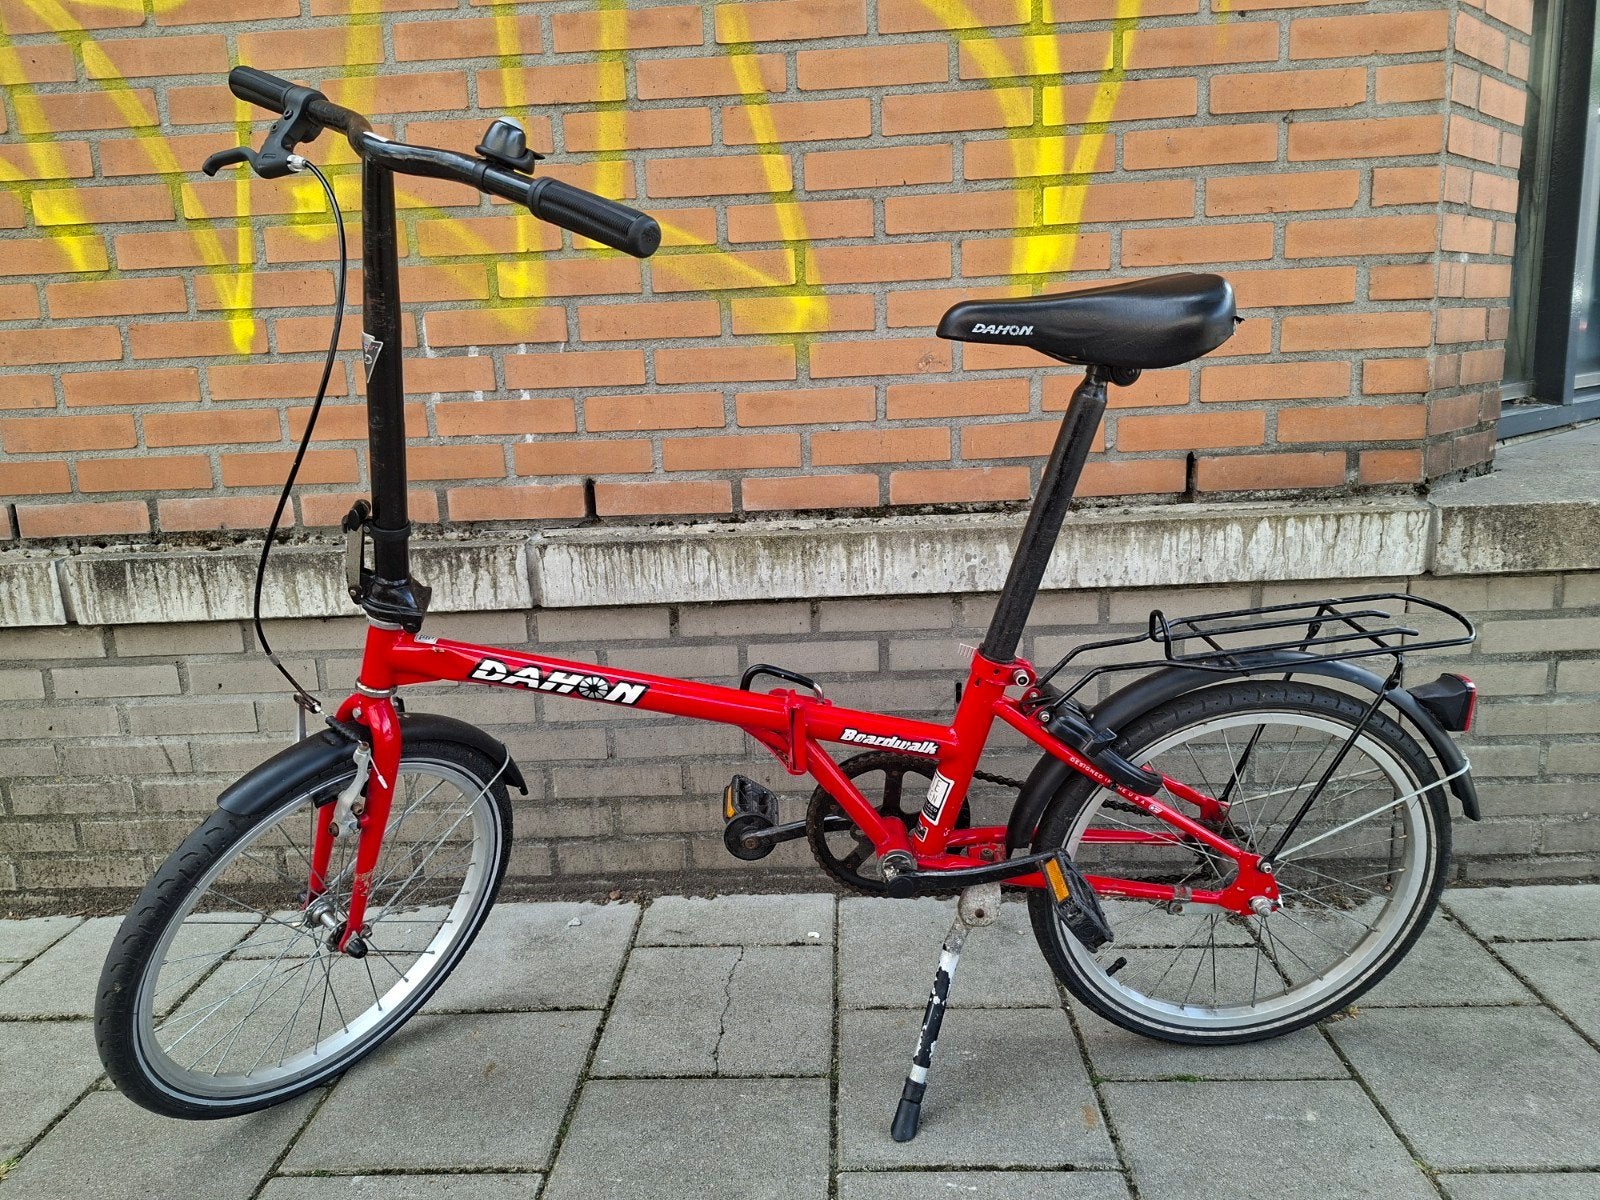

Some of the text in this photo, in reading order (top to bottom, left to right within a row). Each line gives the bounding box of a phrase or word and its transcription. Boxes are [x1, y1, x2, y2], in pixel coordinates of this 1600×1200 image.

[971, 322, 1034, 336] DAHON
[468, 657, 649, 706] DAHON
[839, 728, 939, 755] Boardwalk
[1069, 757, 1104, 779] DESIGNED
